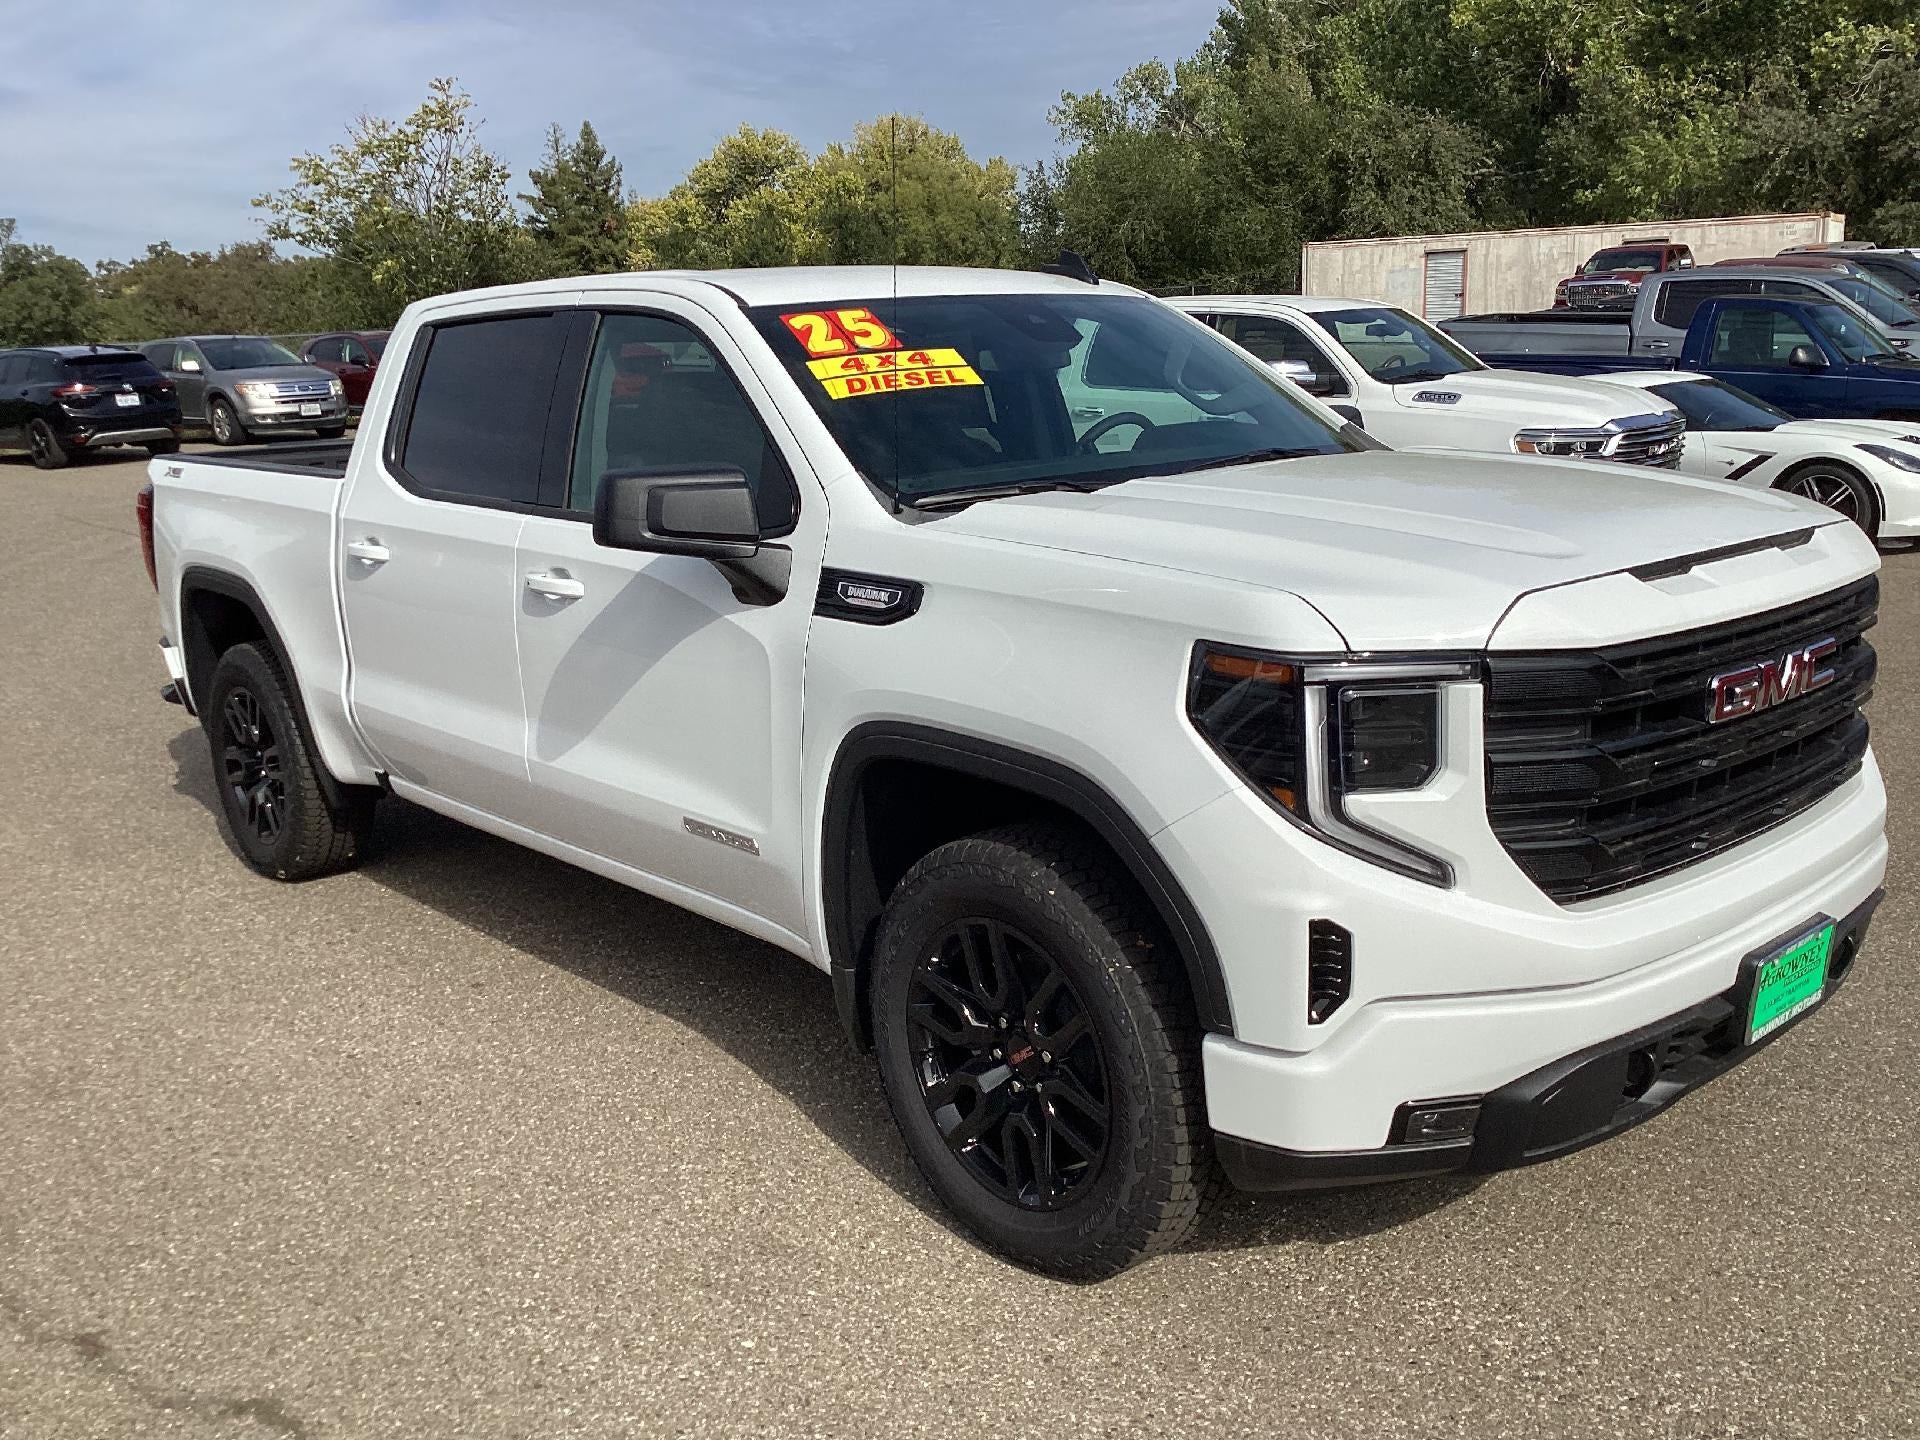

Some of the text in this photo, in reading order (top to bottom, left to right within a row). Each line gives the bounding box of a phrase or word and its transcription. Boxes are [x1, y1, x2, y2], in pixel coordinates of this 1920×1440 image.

[788, 309, 891, 353] 25
[845, 369, 965, 394] DIESEL
[847, 586, 890, 602] DURAMAX
[1706, 636, 1837, 724] GMC
[1767, 941, 1824, 987] GROWNEY
[1752, 1009, 1789, 1041] GROWNEY
[1791, 991, 1822, 1017] MOTORS
